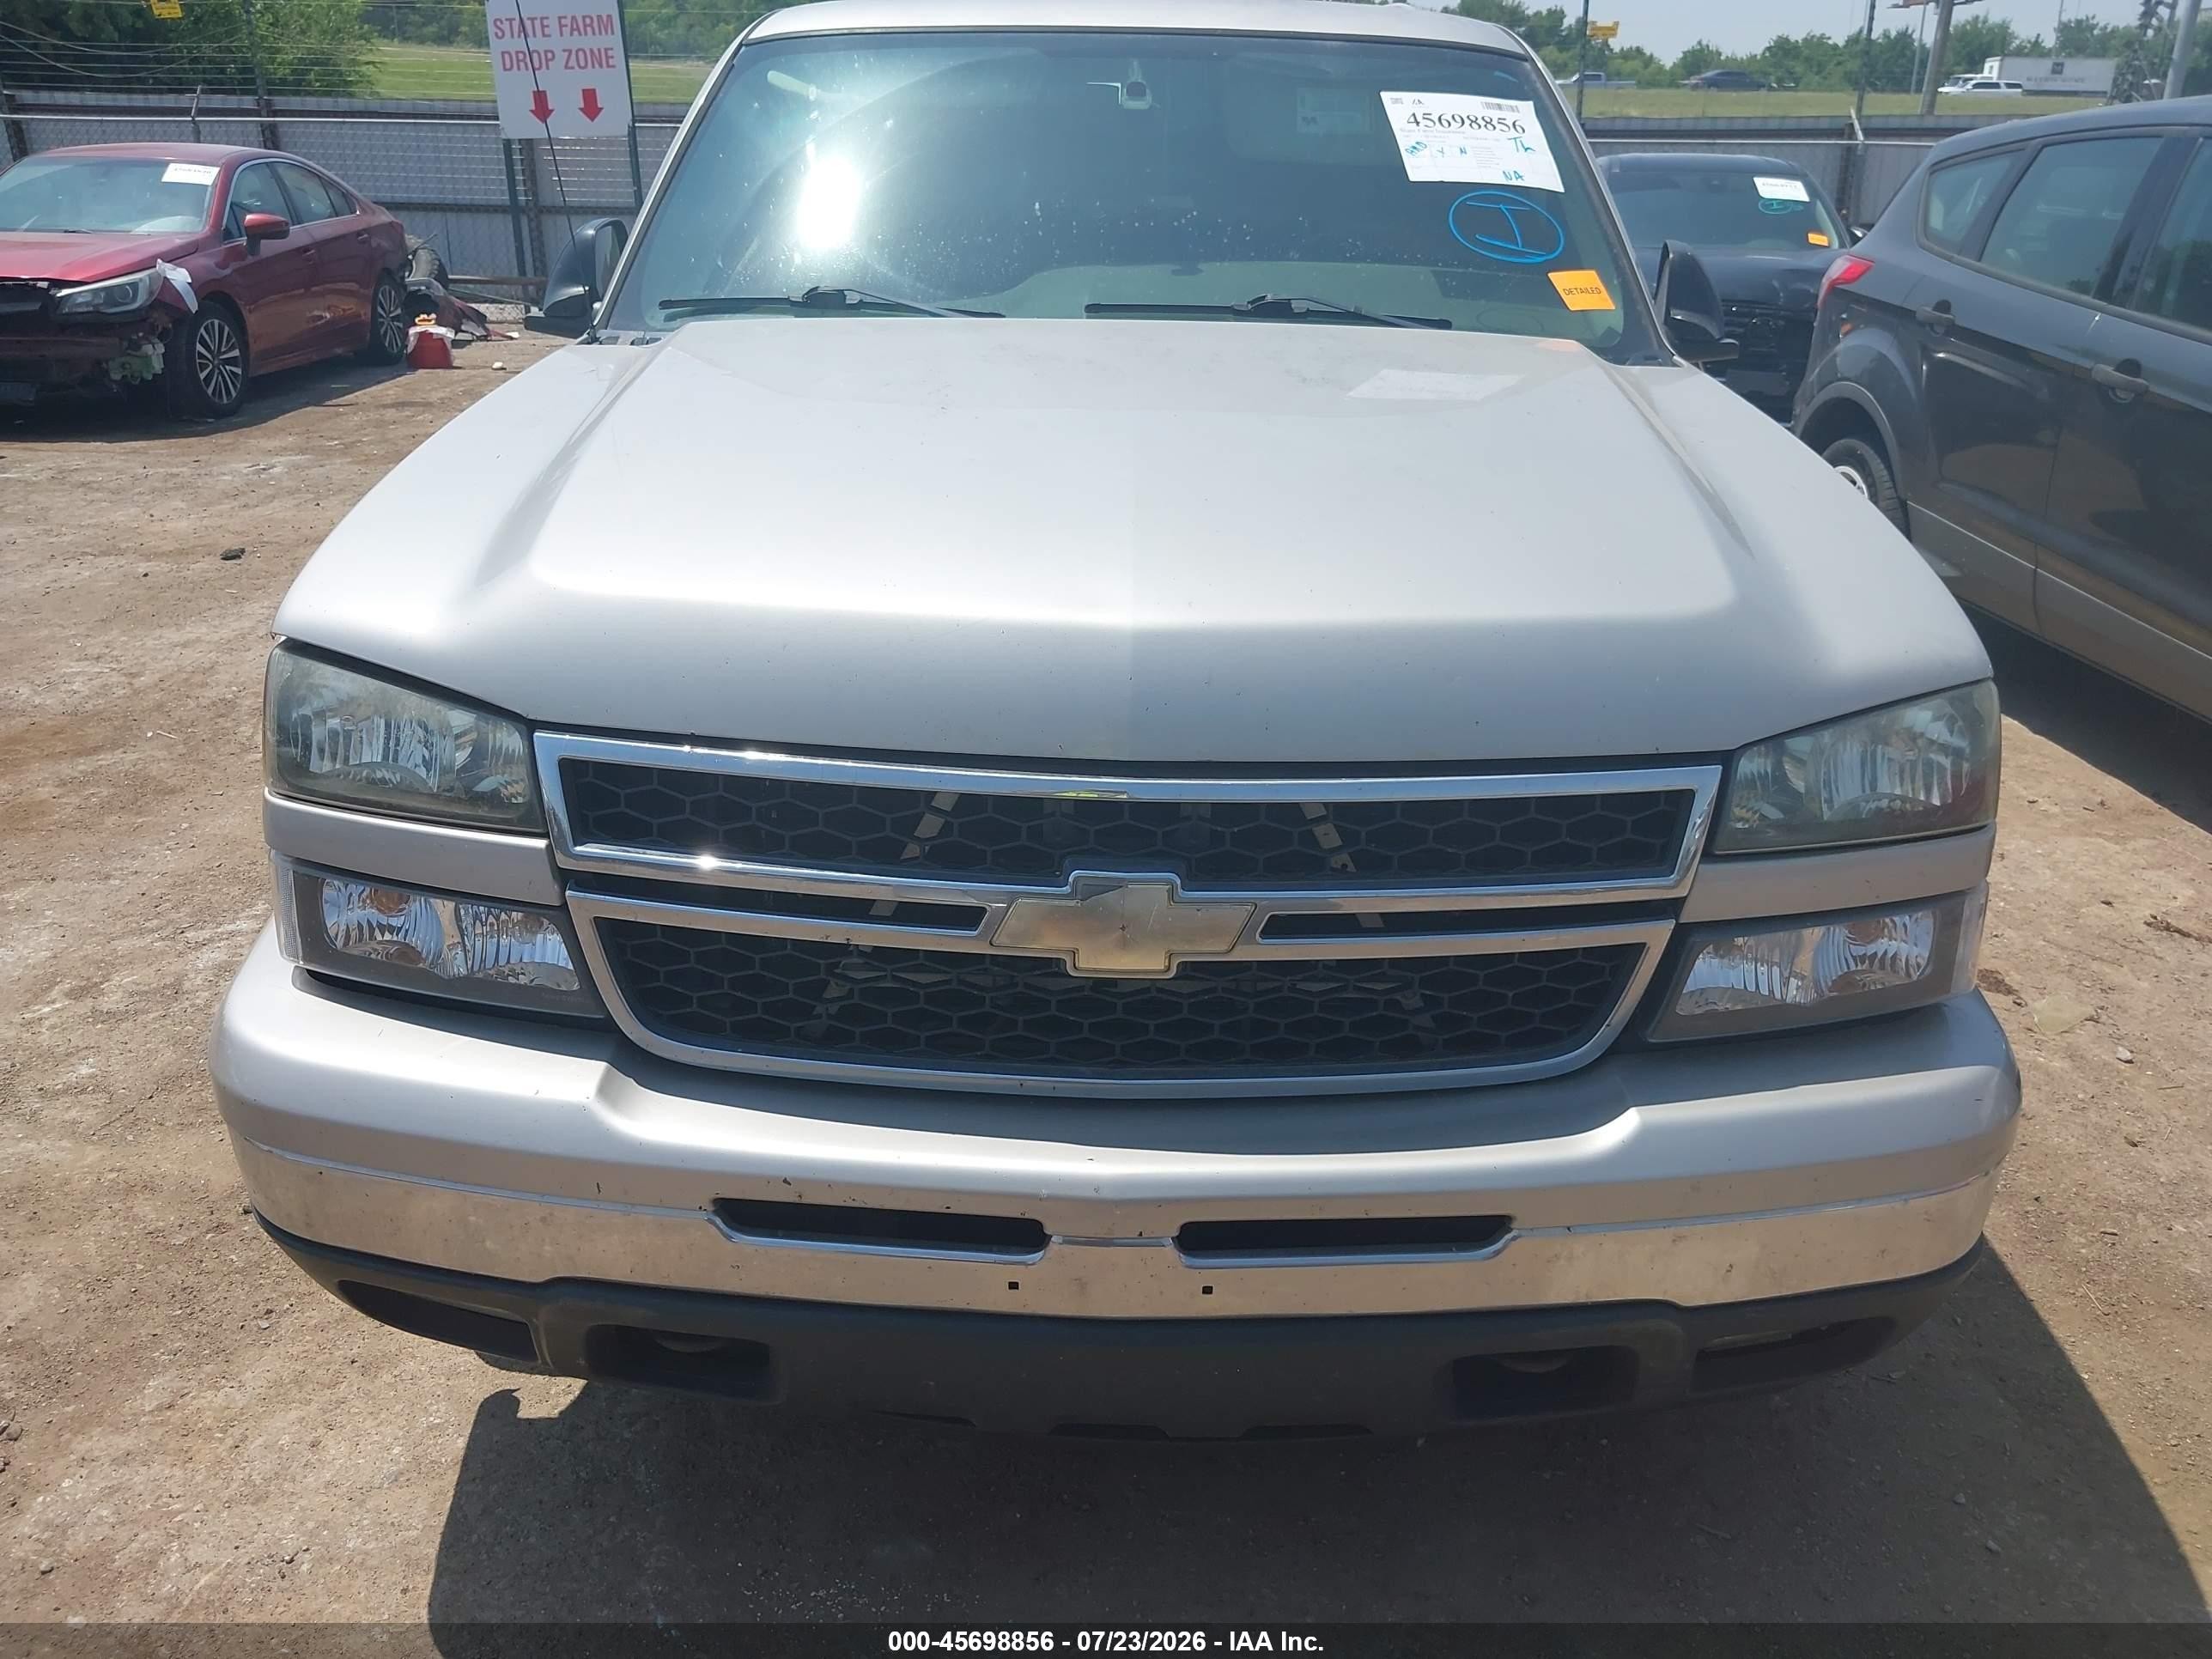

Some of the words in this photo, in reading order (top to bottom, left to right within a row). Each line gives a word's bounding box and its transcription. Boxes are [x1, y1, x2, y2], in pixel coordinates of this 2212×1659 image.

[493, 16, 551, 40] STATE
[556, 14, 615, 37] FARM
[501, 49, 556, 71] DROP
[562, 47, 616, 70] ZONE
[1407, 112, 1526, 135] 45698856
[1563, 287, 1601, 295] DETAILED
